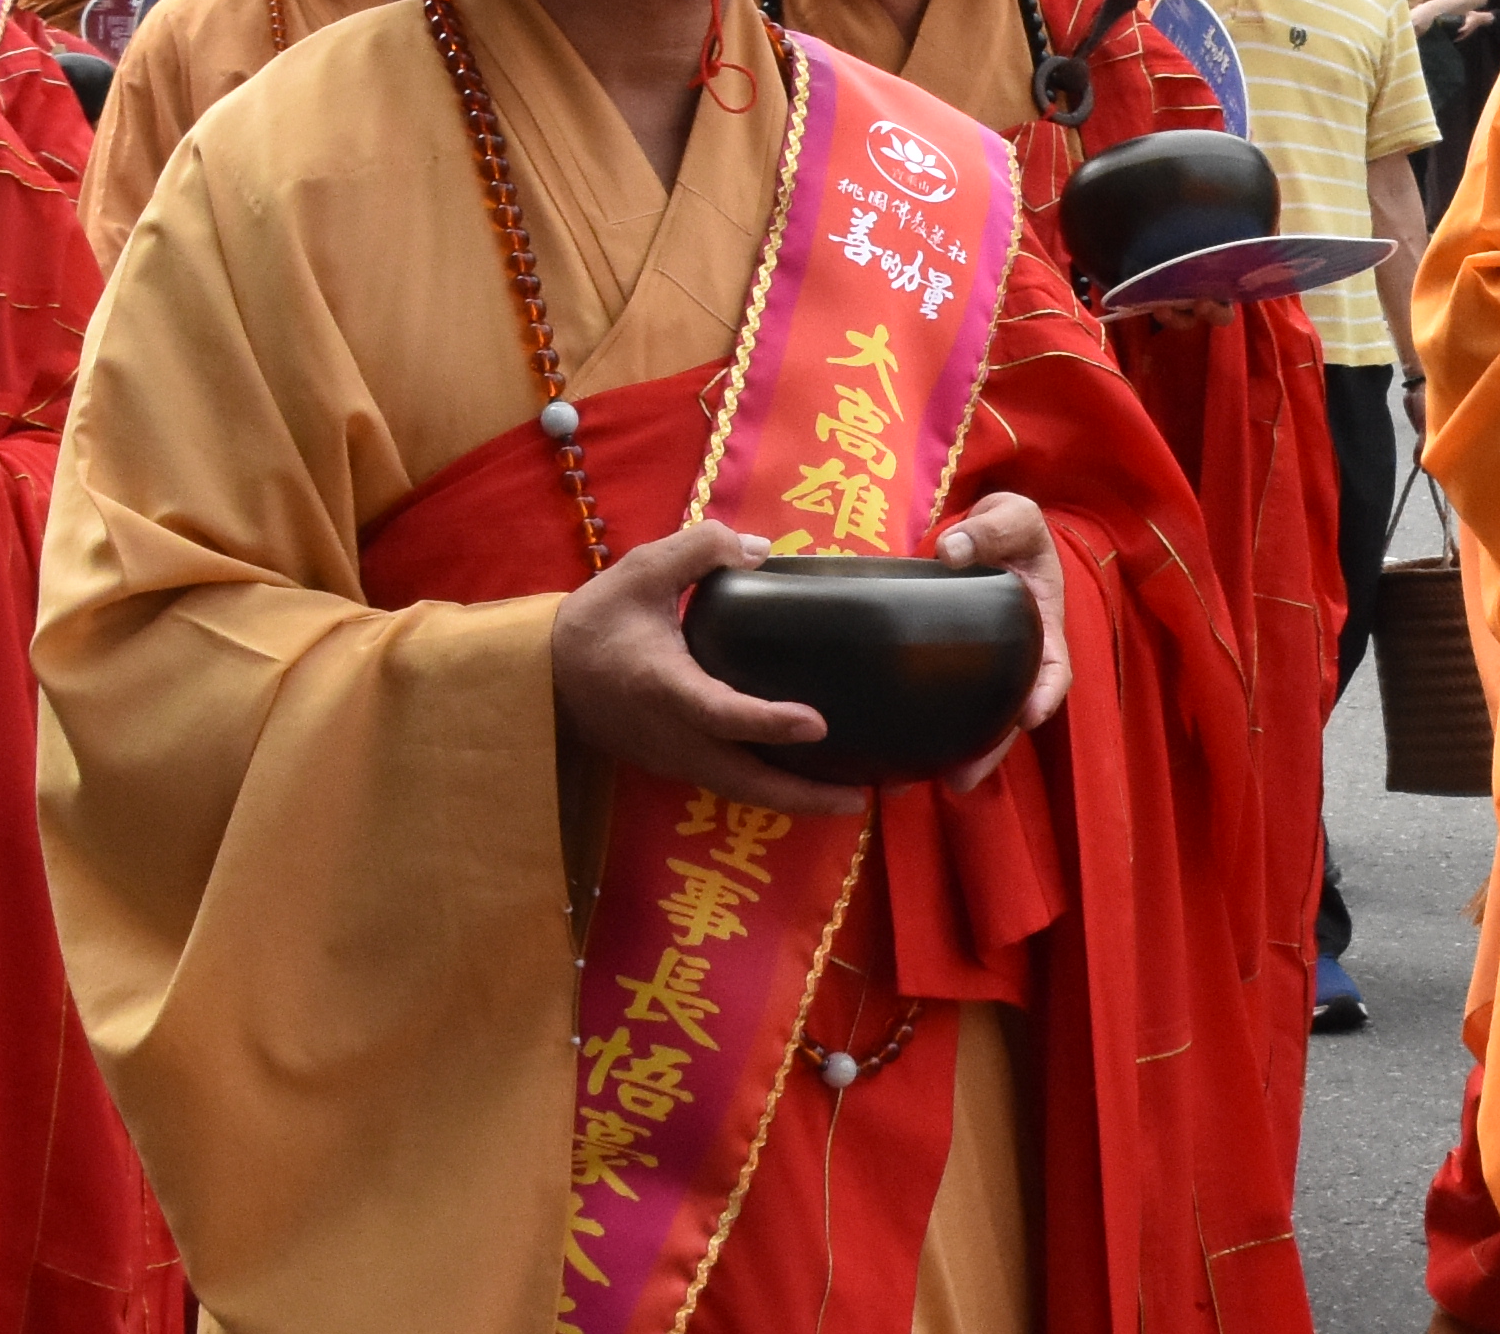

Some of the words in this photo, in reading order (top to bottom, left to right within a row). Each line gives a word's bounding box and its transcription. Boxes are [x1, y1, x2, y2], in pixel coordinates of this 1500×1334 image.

[828, 207, 955, 320] 善的力量
[837, 178, 968, 265] 桃園佛教蓮社
[768, 323, 905, 557] 大高雄
